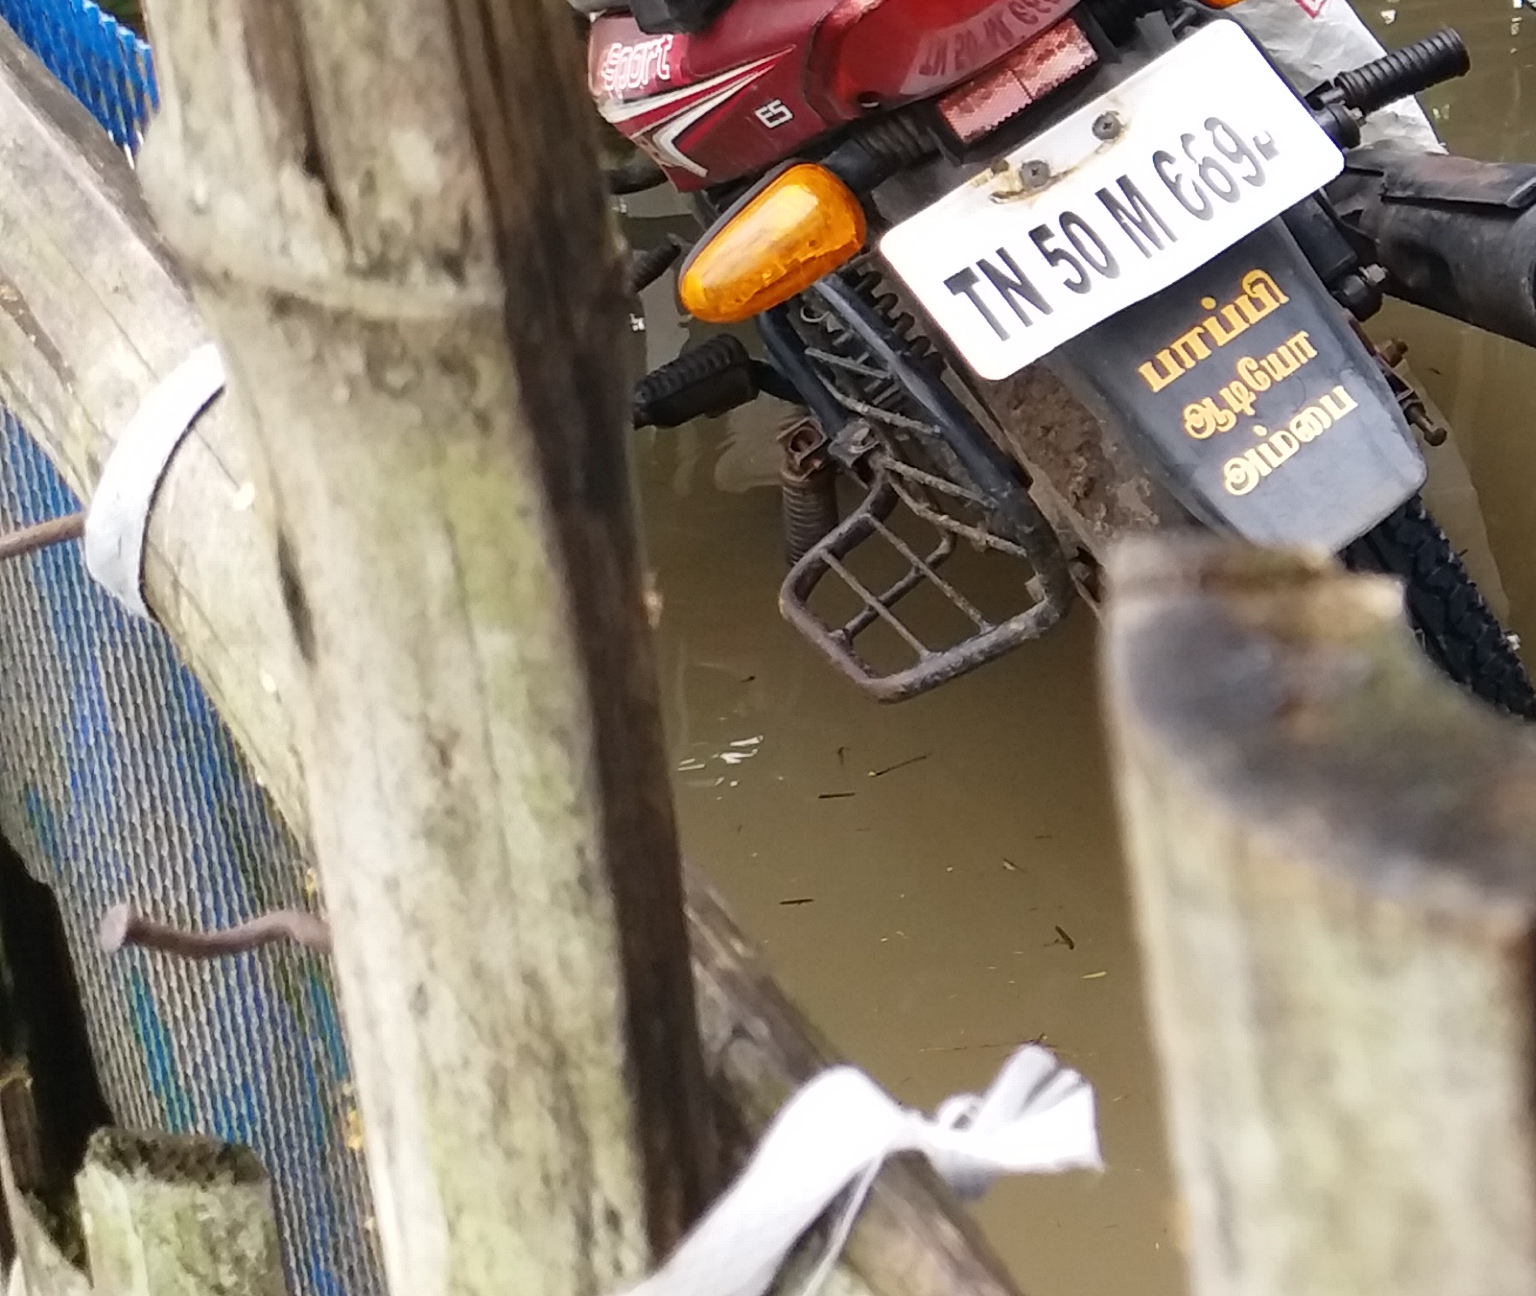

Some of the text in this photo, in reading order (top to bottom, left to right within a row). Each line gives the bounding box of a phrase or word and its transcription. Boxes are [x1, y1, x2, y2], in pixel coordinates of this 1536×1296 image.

[754, 99, 794, 129] ES
[943, 247, 1054, 341] TN
[1028, 211, 1121, 295] 50
[1094, 174, 1179, 259] M
[1138, 269, 1290, 392] பாப்பி
[1183, 330, 1318, 439] ஆடியோ
[1224, 385, 1358, 496] அம்பை
